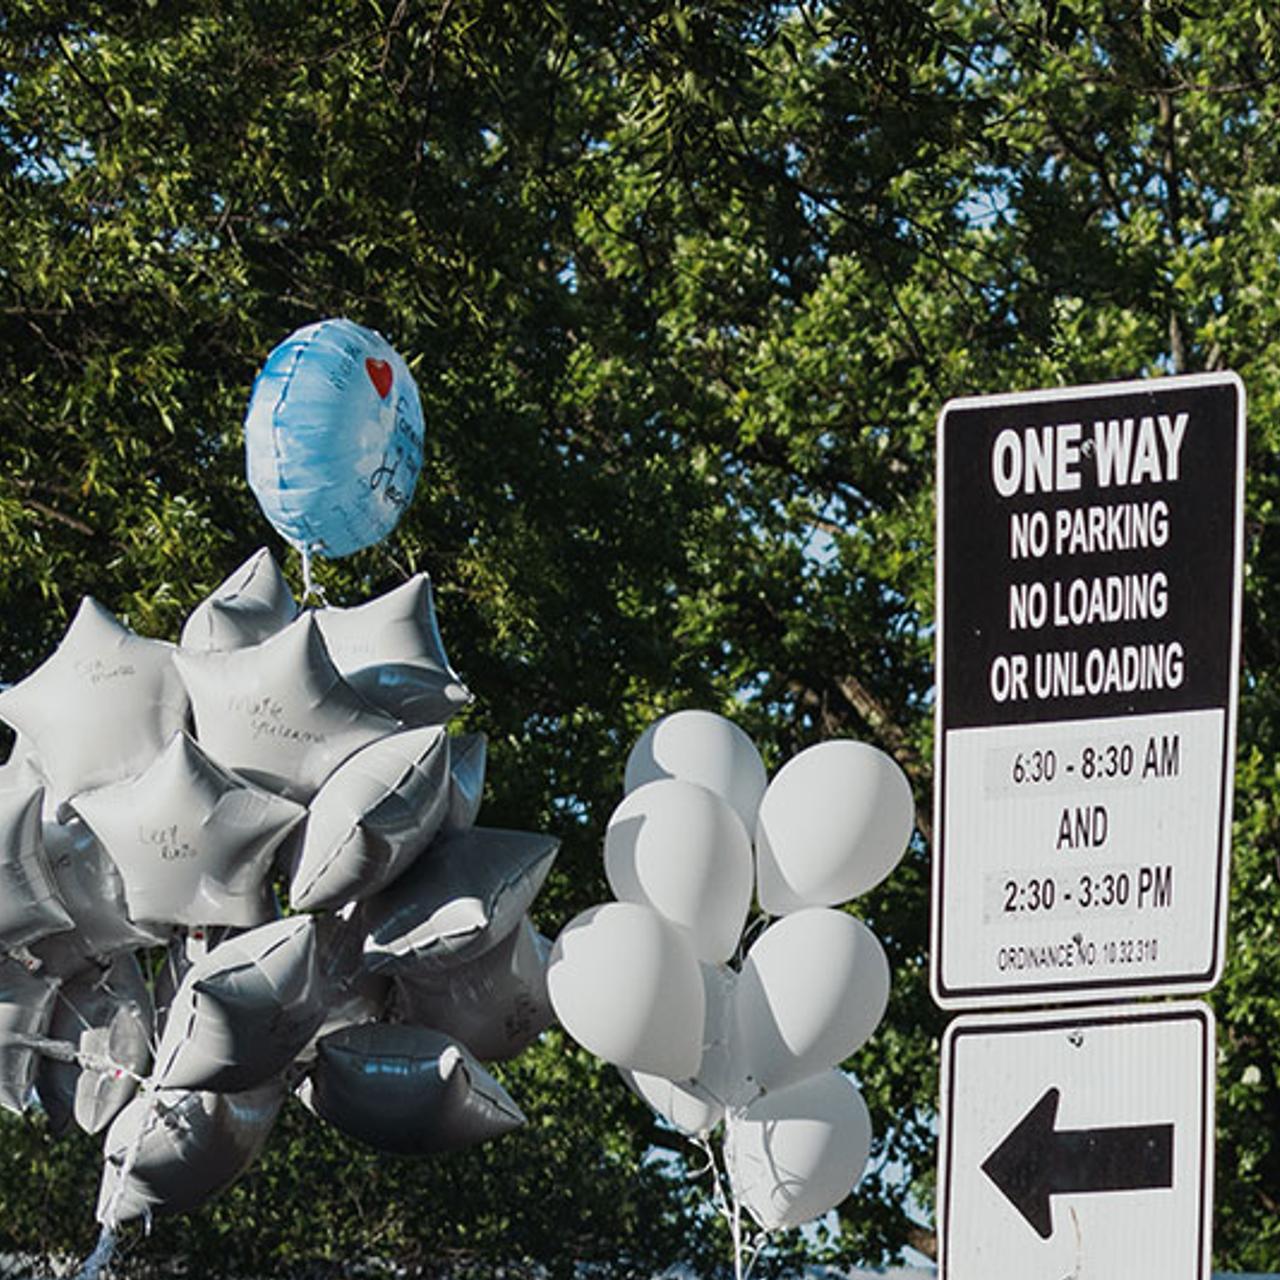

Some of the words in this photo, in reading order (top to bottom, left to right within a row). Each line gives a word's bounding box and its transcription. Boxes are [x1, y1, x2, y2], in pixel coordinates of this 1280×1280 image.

[991, 424, 1082, 497] ONE
[1094, 413, 1189, 488] WAY
[1011, 512, 1048, 560] NO
[1056, 500, 1169, 556] PARKING
[1009, 582, 1047, 630] NO
[1054, 571, 1168, 627] LOADING
[990, 654, 1029, 702] OR
[1035, 641, 1184, 699] UNLOADING
[1012, 750, 1056, 784] 6:30
[1082, 744, 1134, 779] 8:30
[1142, 735, 1179, 778] AM
[1056, 806, 1108, 849] AND
[1003, 878, 1055, 913] 2:30
[1078, 872, 1129, 907] 3:30
[1137, 866, 1173, 909] PM
[998, 944, 1074, 971] ORDINANCE
